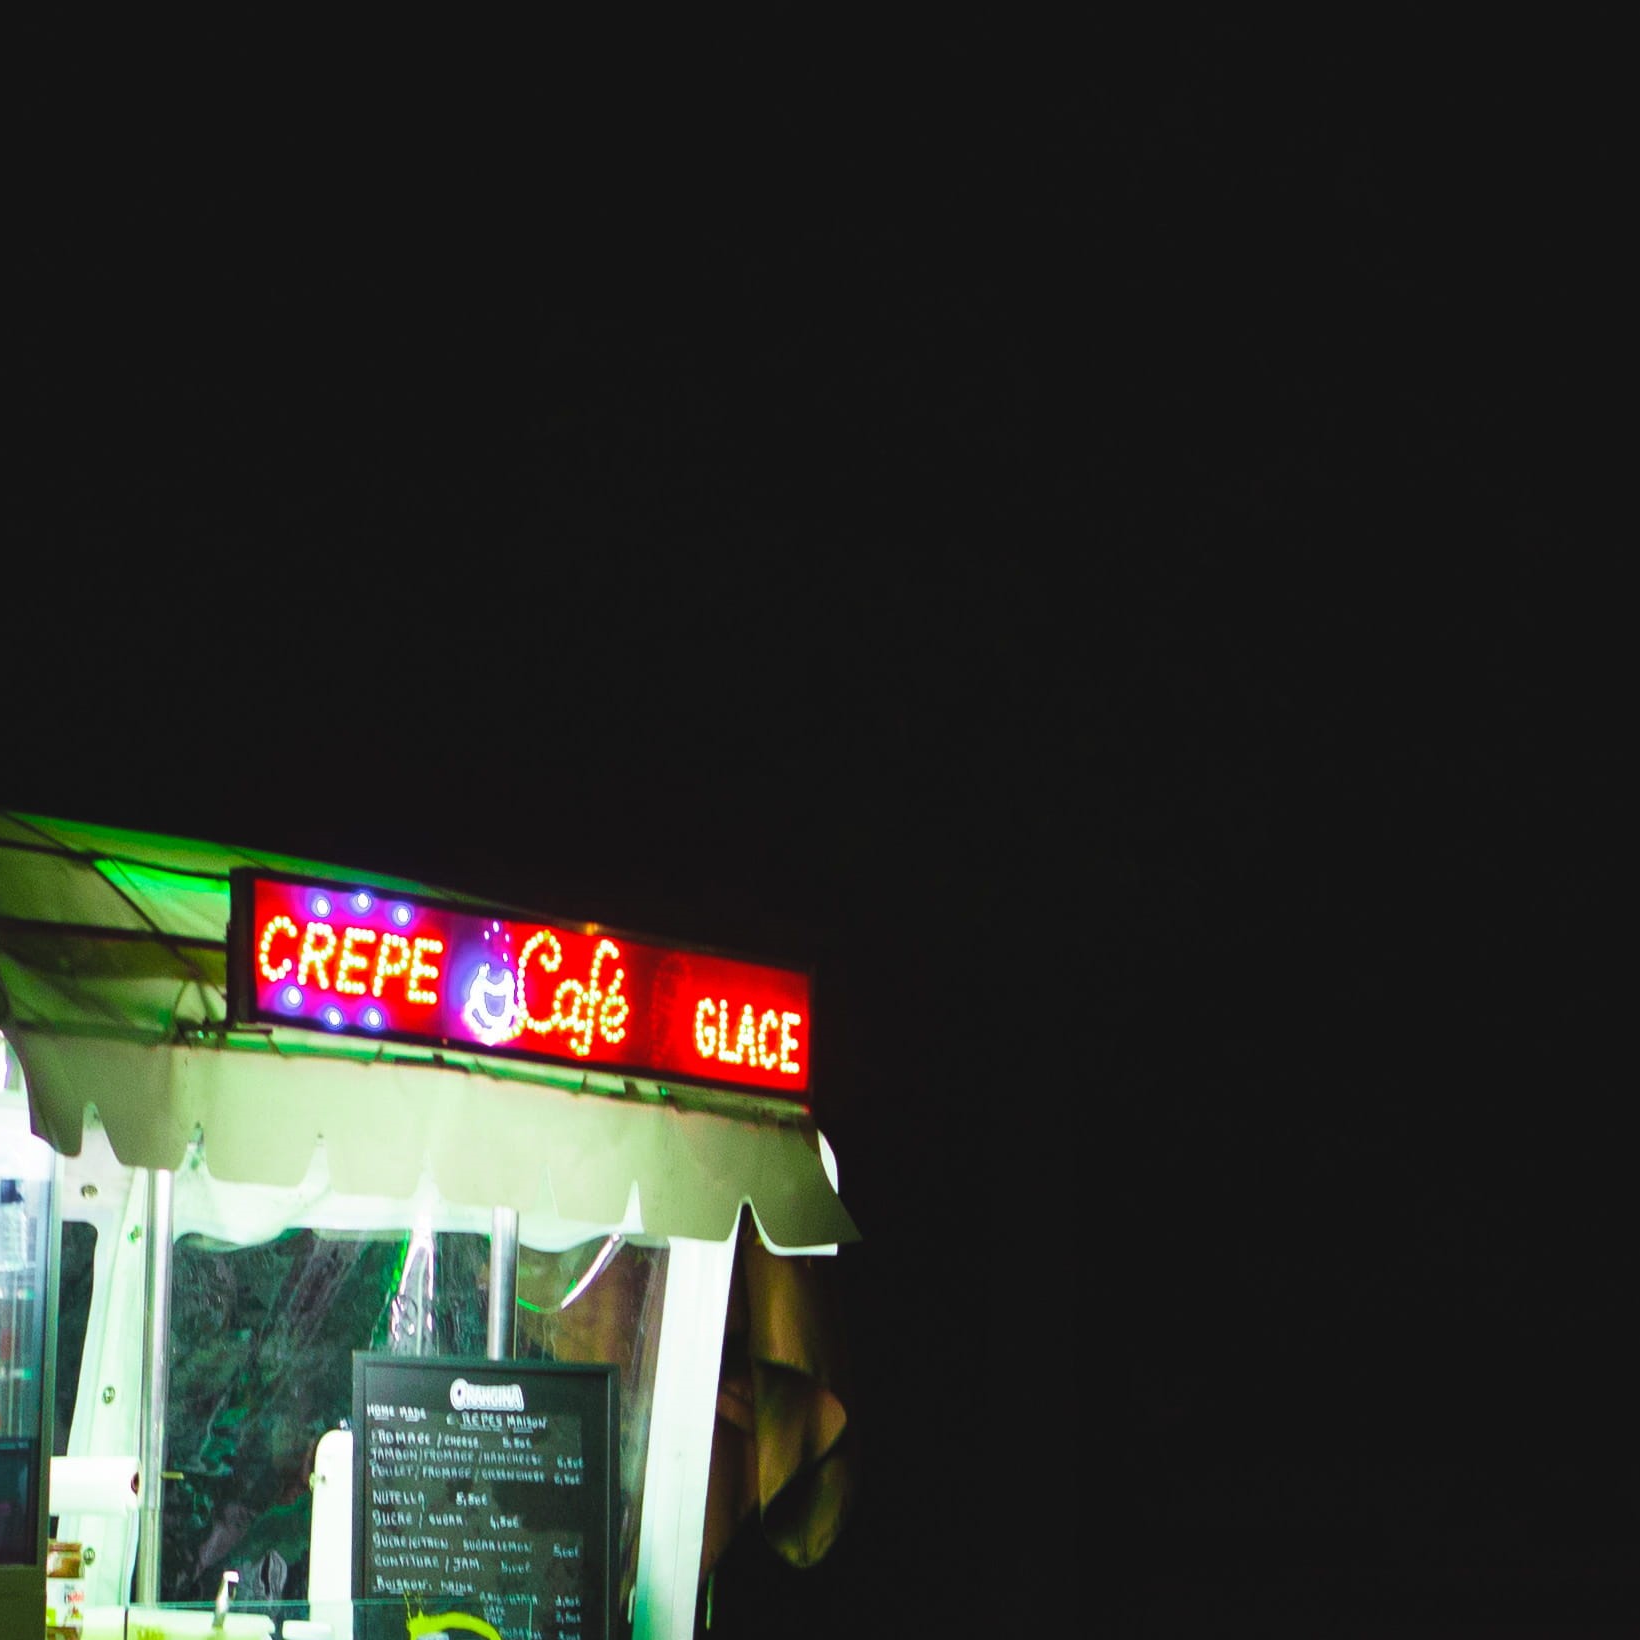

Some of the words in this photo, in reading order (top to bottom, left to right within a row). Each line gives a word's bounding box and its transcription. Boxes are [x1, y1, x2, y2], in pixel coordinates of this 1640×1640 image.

[258, 914, 444, 1006] CREPE
[513, 929, 631, 1056] Café
[694, 997, 802, 1075] GLACE
[372, 1489, 426, 1512] NUTELLA
